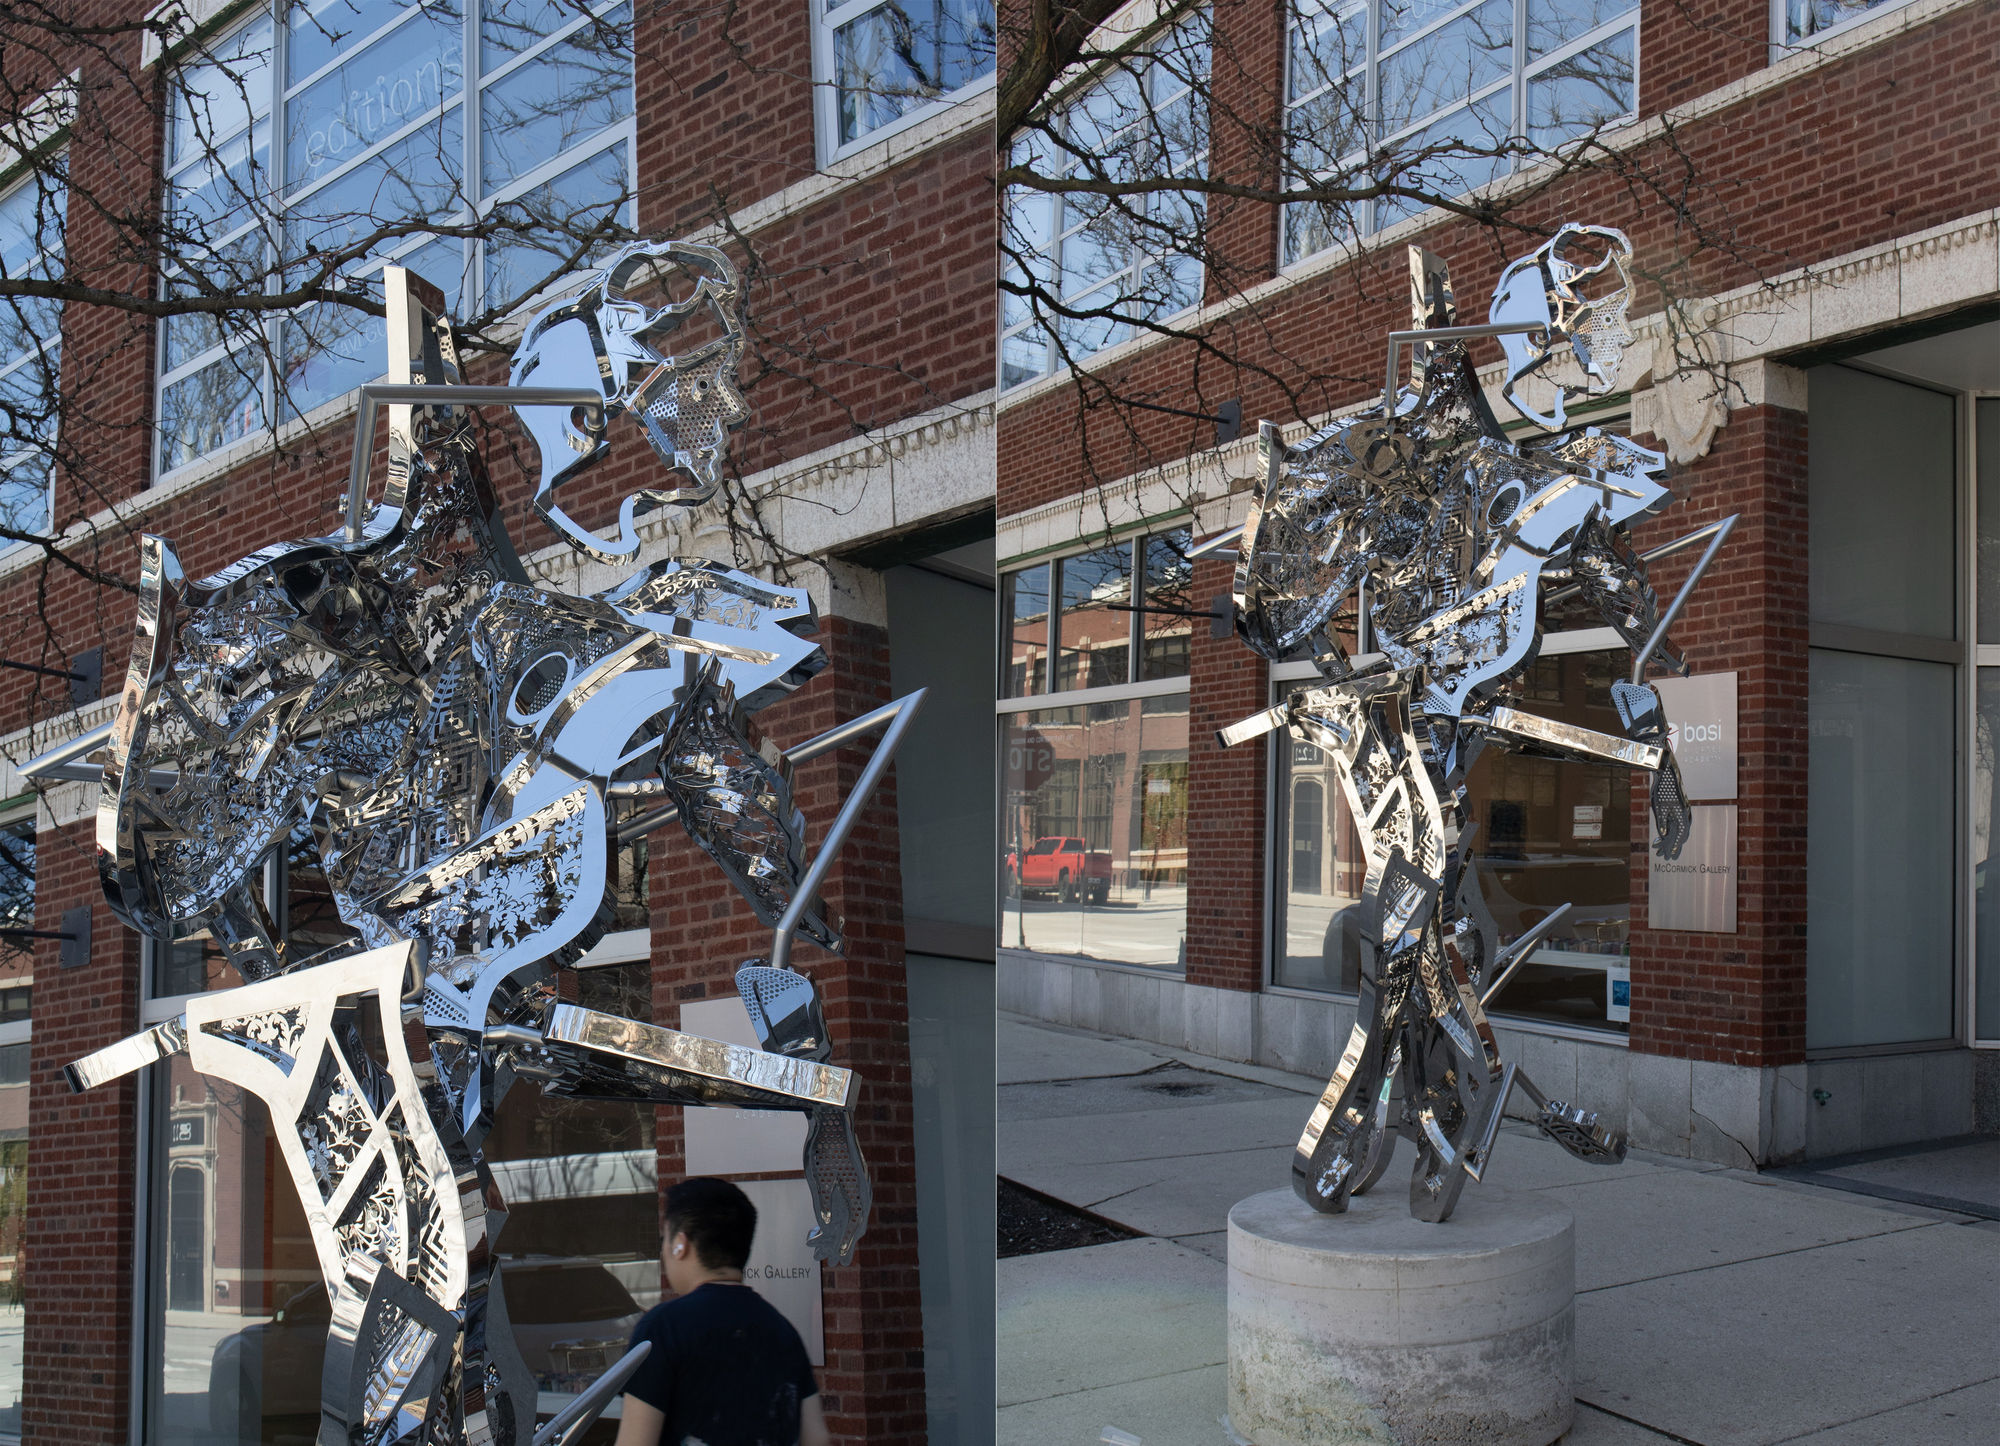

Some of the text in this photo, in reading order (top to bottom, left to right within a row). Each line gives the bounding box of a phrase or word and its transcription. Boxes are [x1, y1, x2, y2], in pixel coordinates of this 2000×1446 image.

[306, 47, 461, 167] editions
[1684, 719, 1721, 742] basi
[764, 1264, 811, 1279] GALLERY
